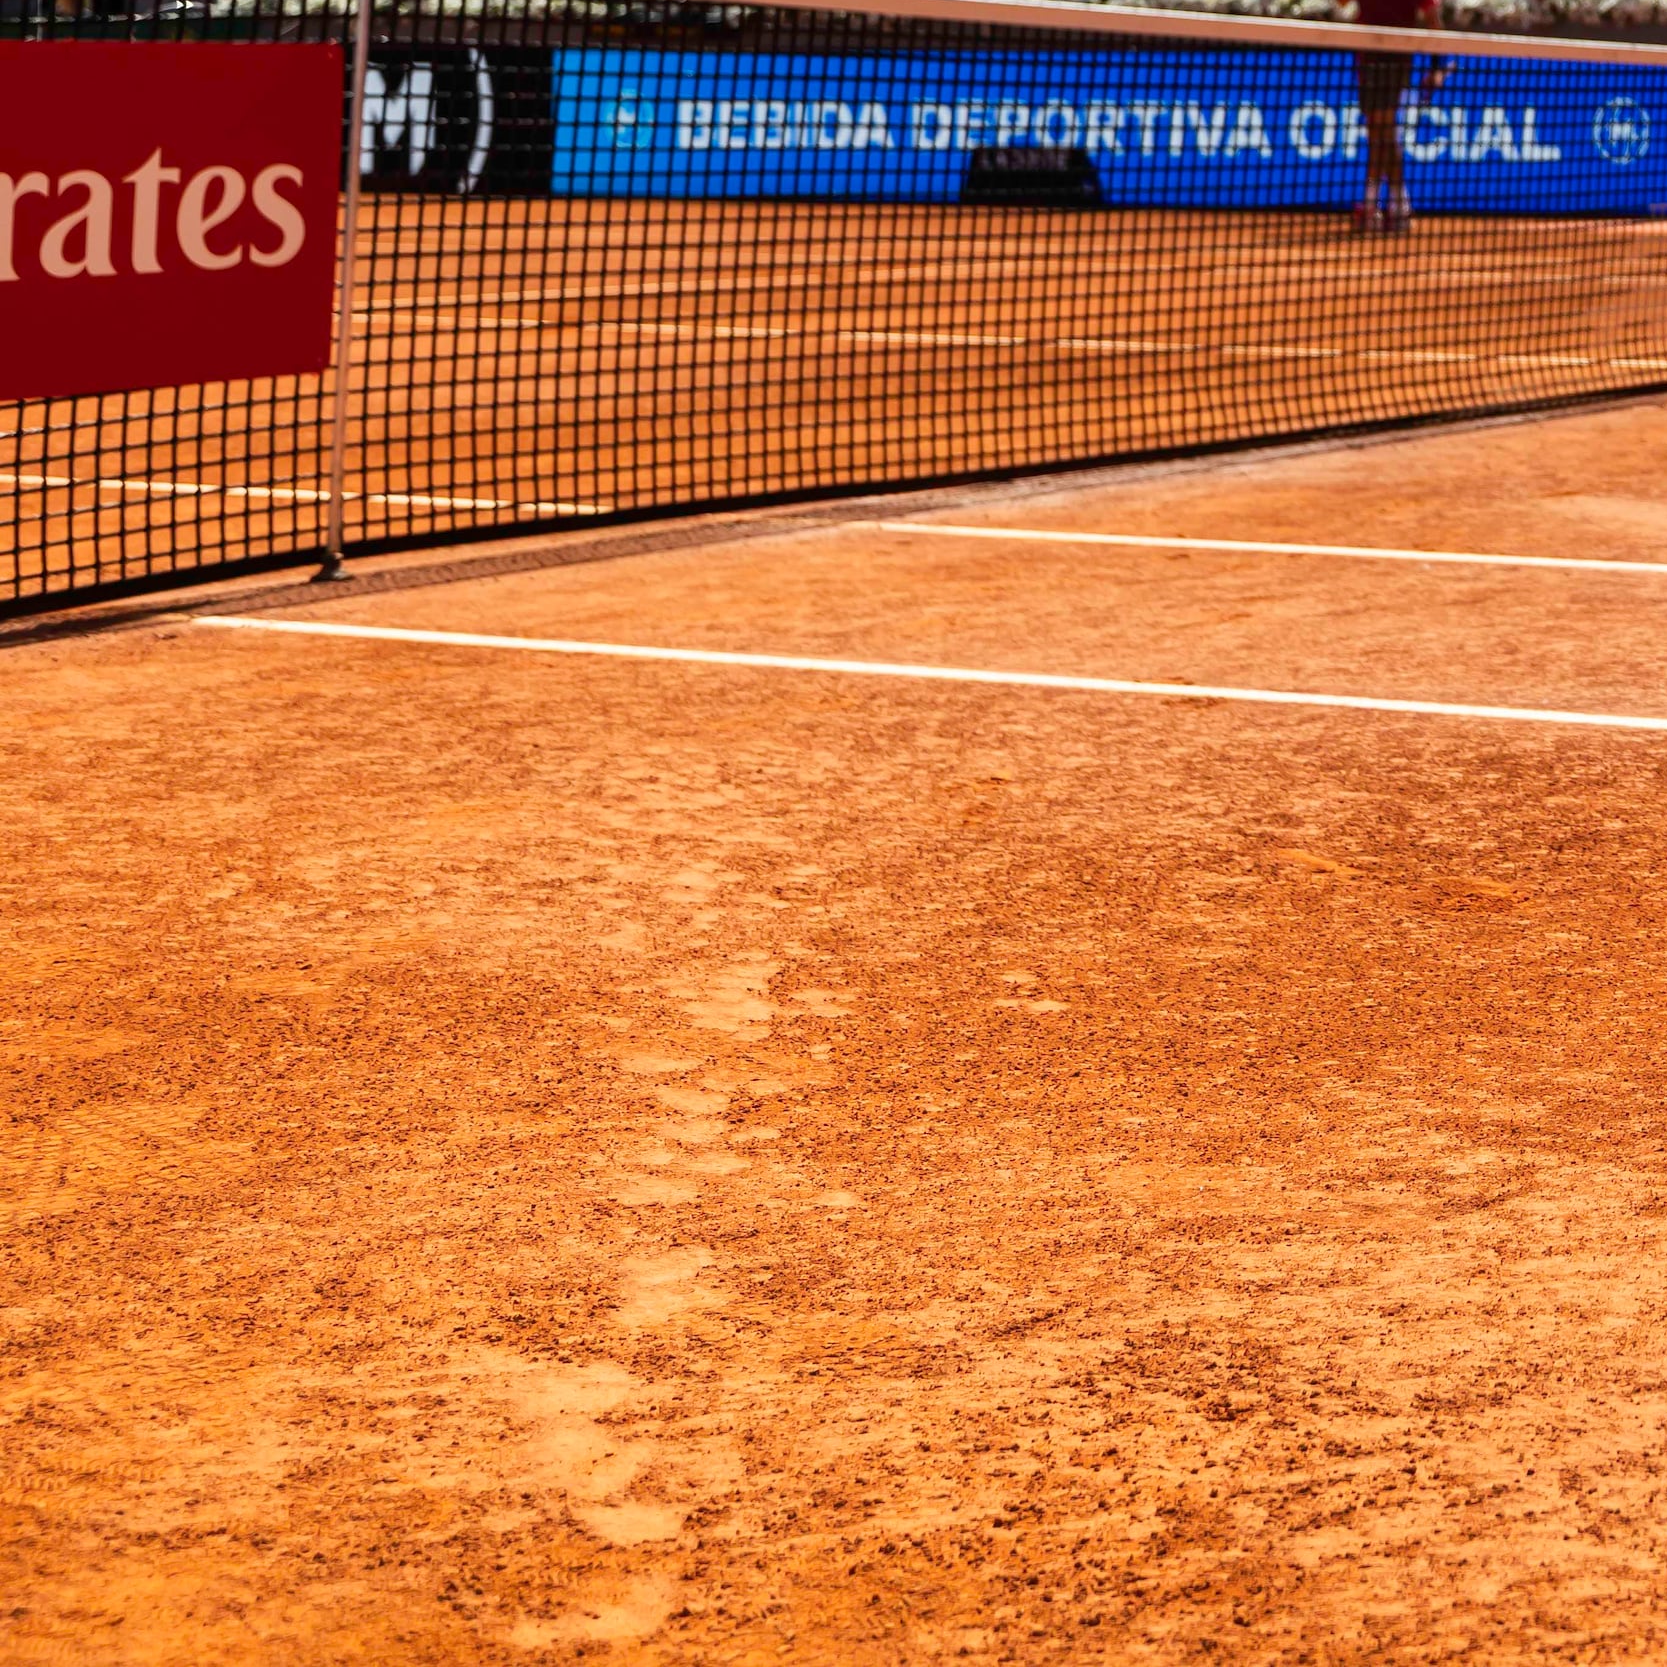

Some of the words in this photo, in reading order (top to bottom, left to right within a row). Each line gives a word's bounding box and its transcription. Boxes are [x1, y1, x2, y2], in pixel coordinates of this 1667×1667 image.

[678, 100, 896, 149] BEBIDA
[912, 99, 1272, 158] DEPORTIVA
[1290, 101, 1561, 162] OFCIAL
